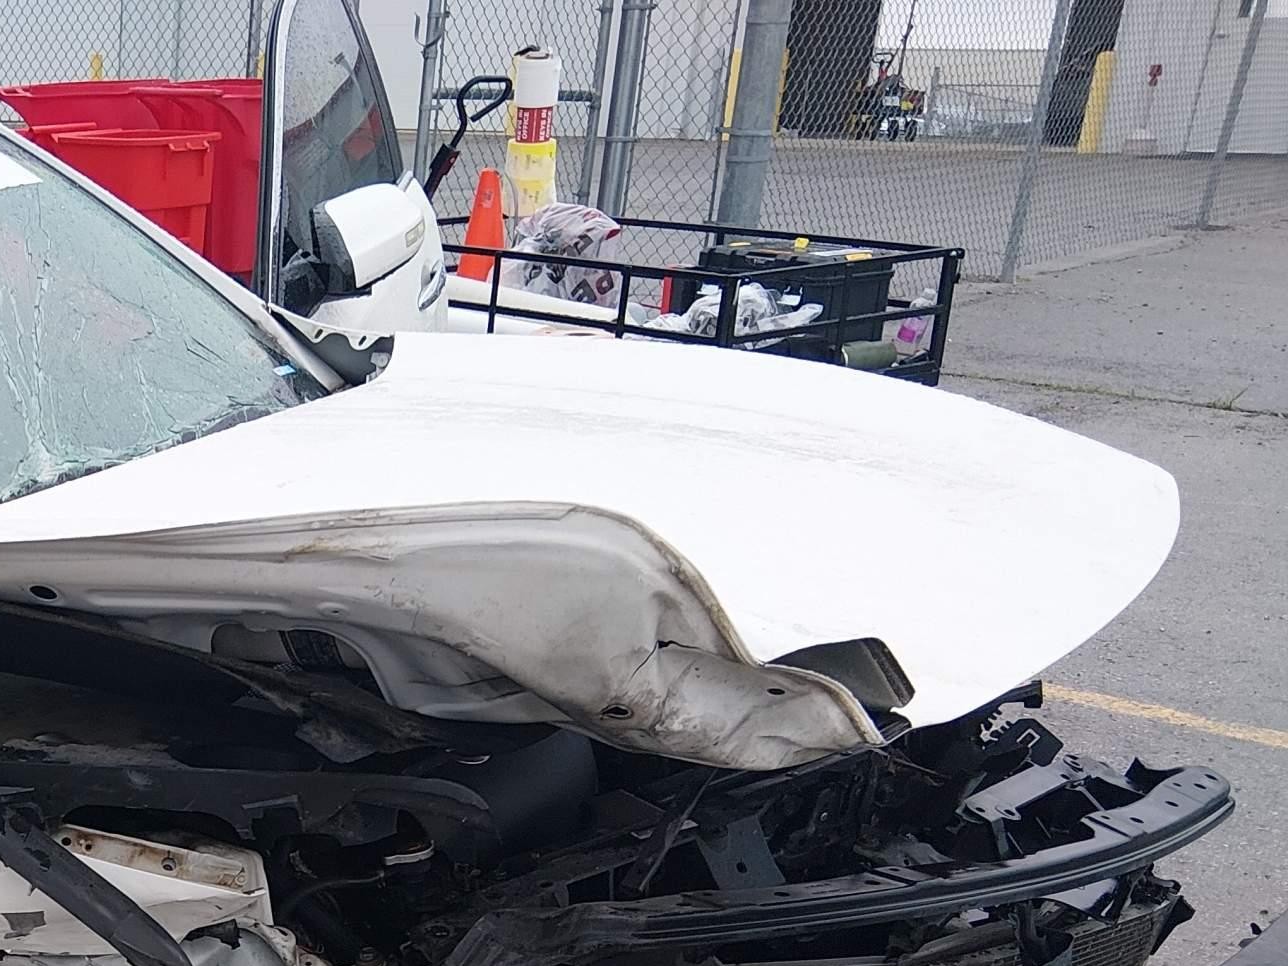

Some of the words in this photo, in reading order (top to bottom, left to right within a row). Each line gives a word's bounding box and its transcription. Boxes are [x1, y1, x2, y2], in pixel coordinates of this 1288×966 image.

[541, 109, 548, 118] IN
[521, 111, 530, 140] OFFICE
[539, 119, 547, 141] KEYS
